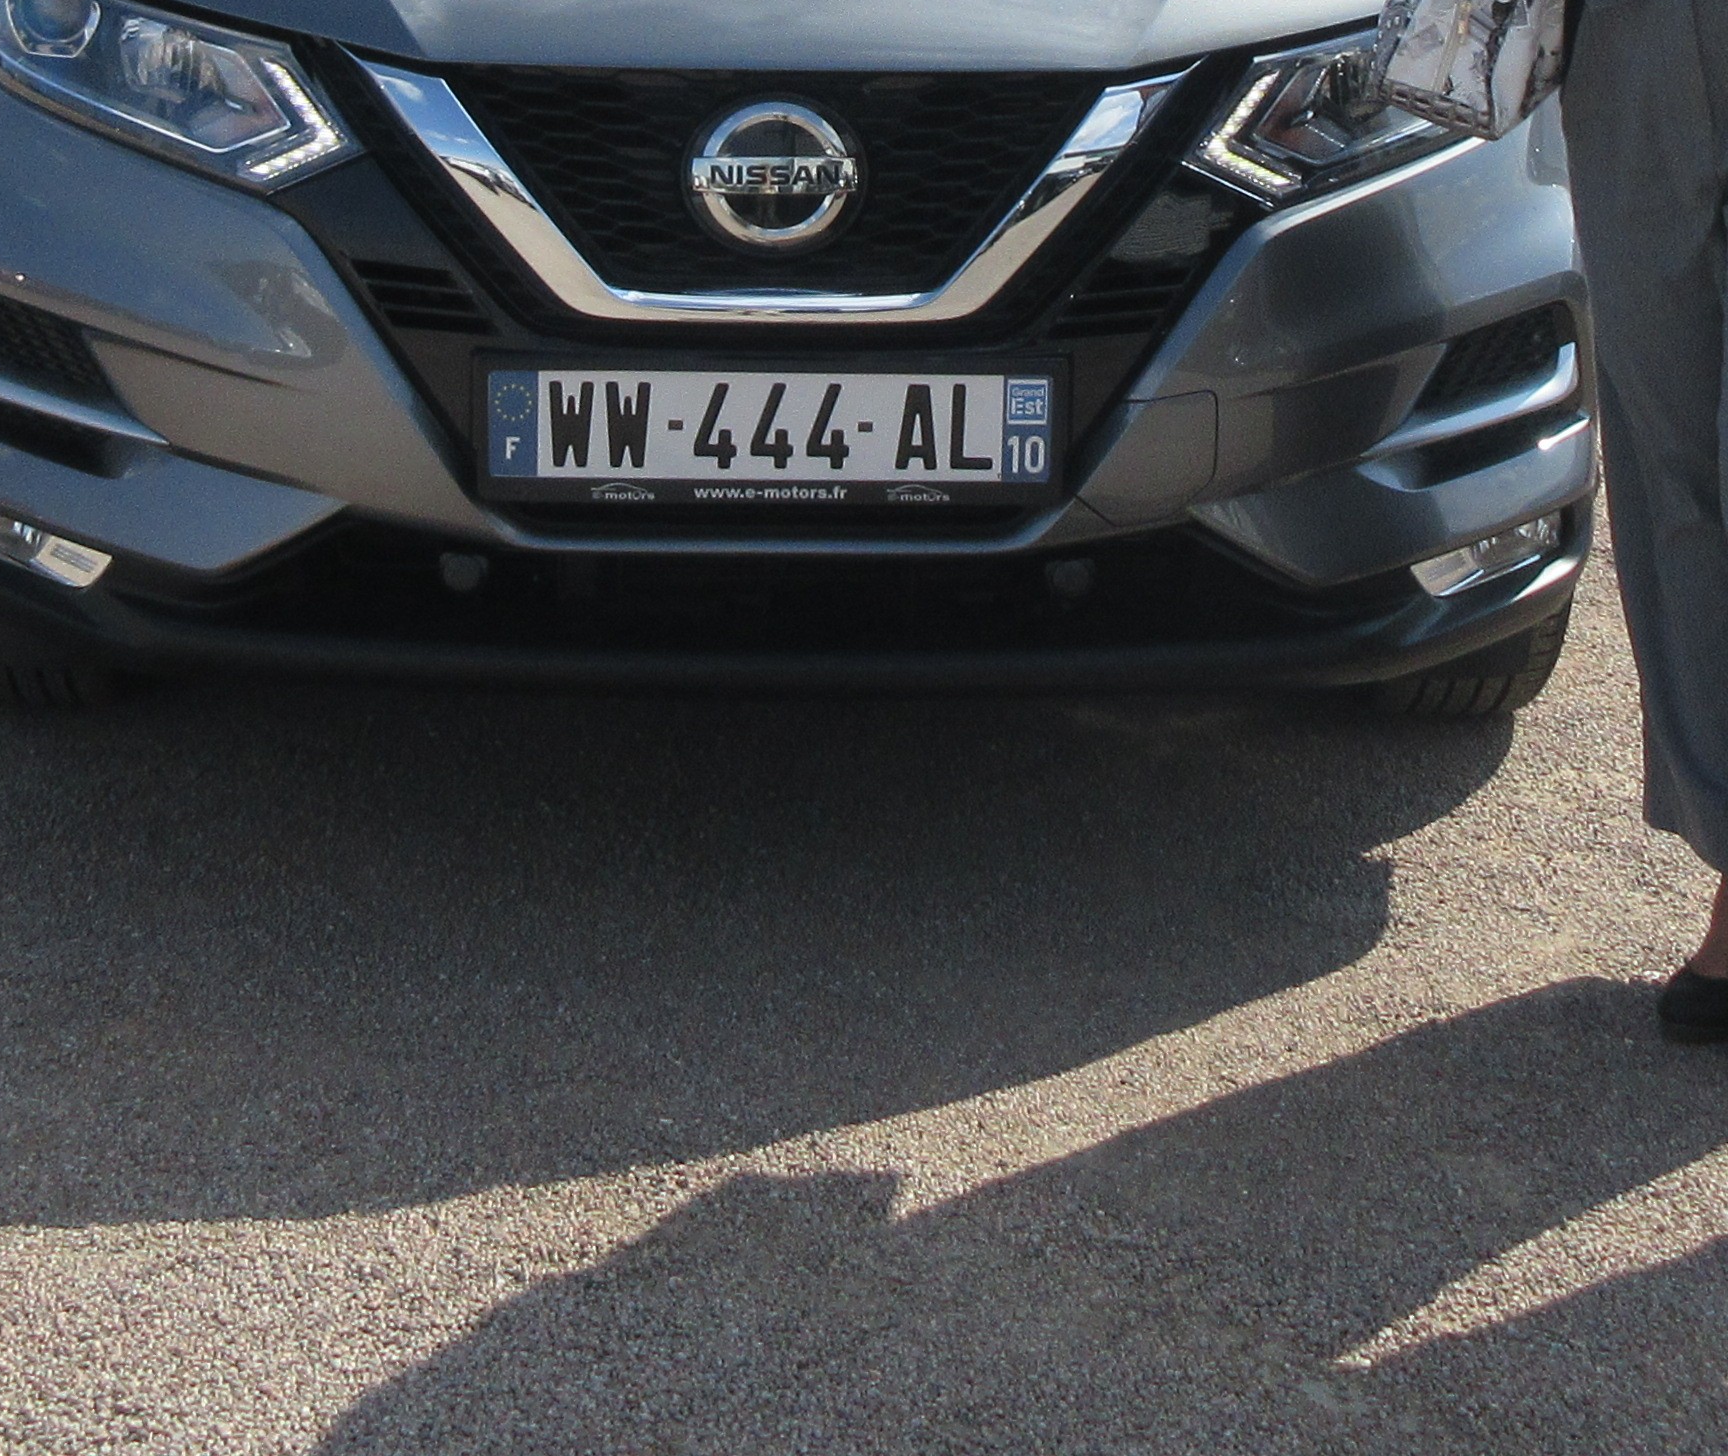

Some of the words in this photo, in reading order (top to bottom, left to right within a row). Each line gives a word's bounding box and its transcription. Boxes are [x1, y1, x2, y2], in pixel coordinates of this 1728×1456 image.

[710, 164, 840, 185] NISSAN
[1012, 387, 1045, 397] Grand
[1011, 397, 1044, 415] Est
[505, 436, 521, 459] F
[1007, 435, 1046, 474] 10
[693, 485, 848, 500] www.e-motors.fr
